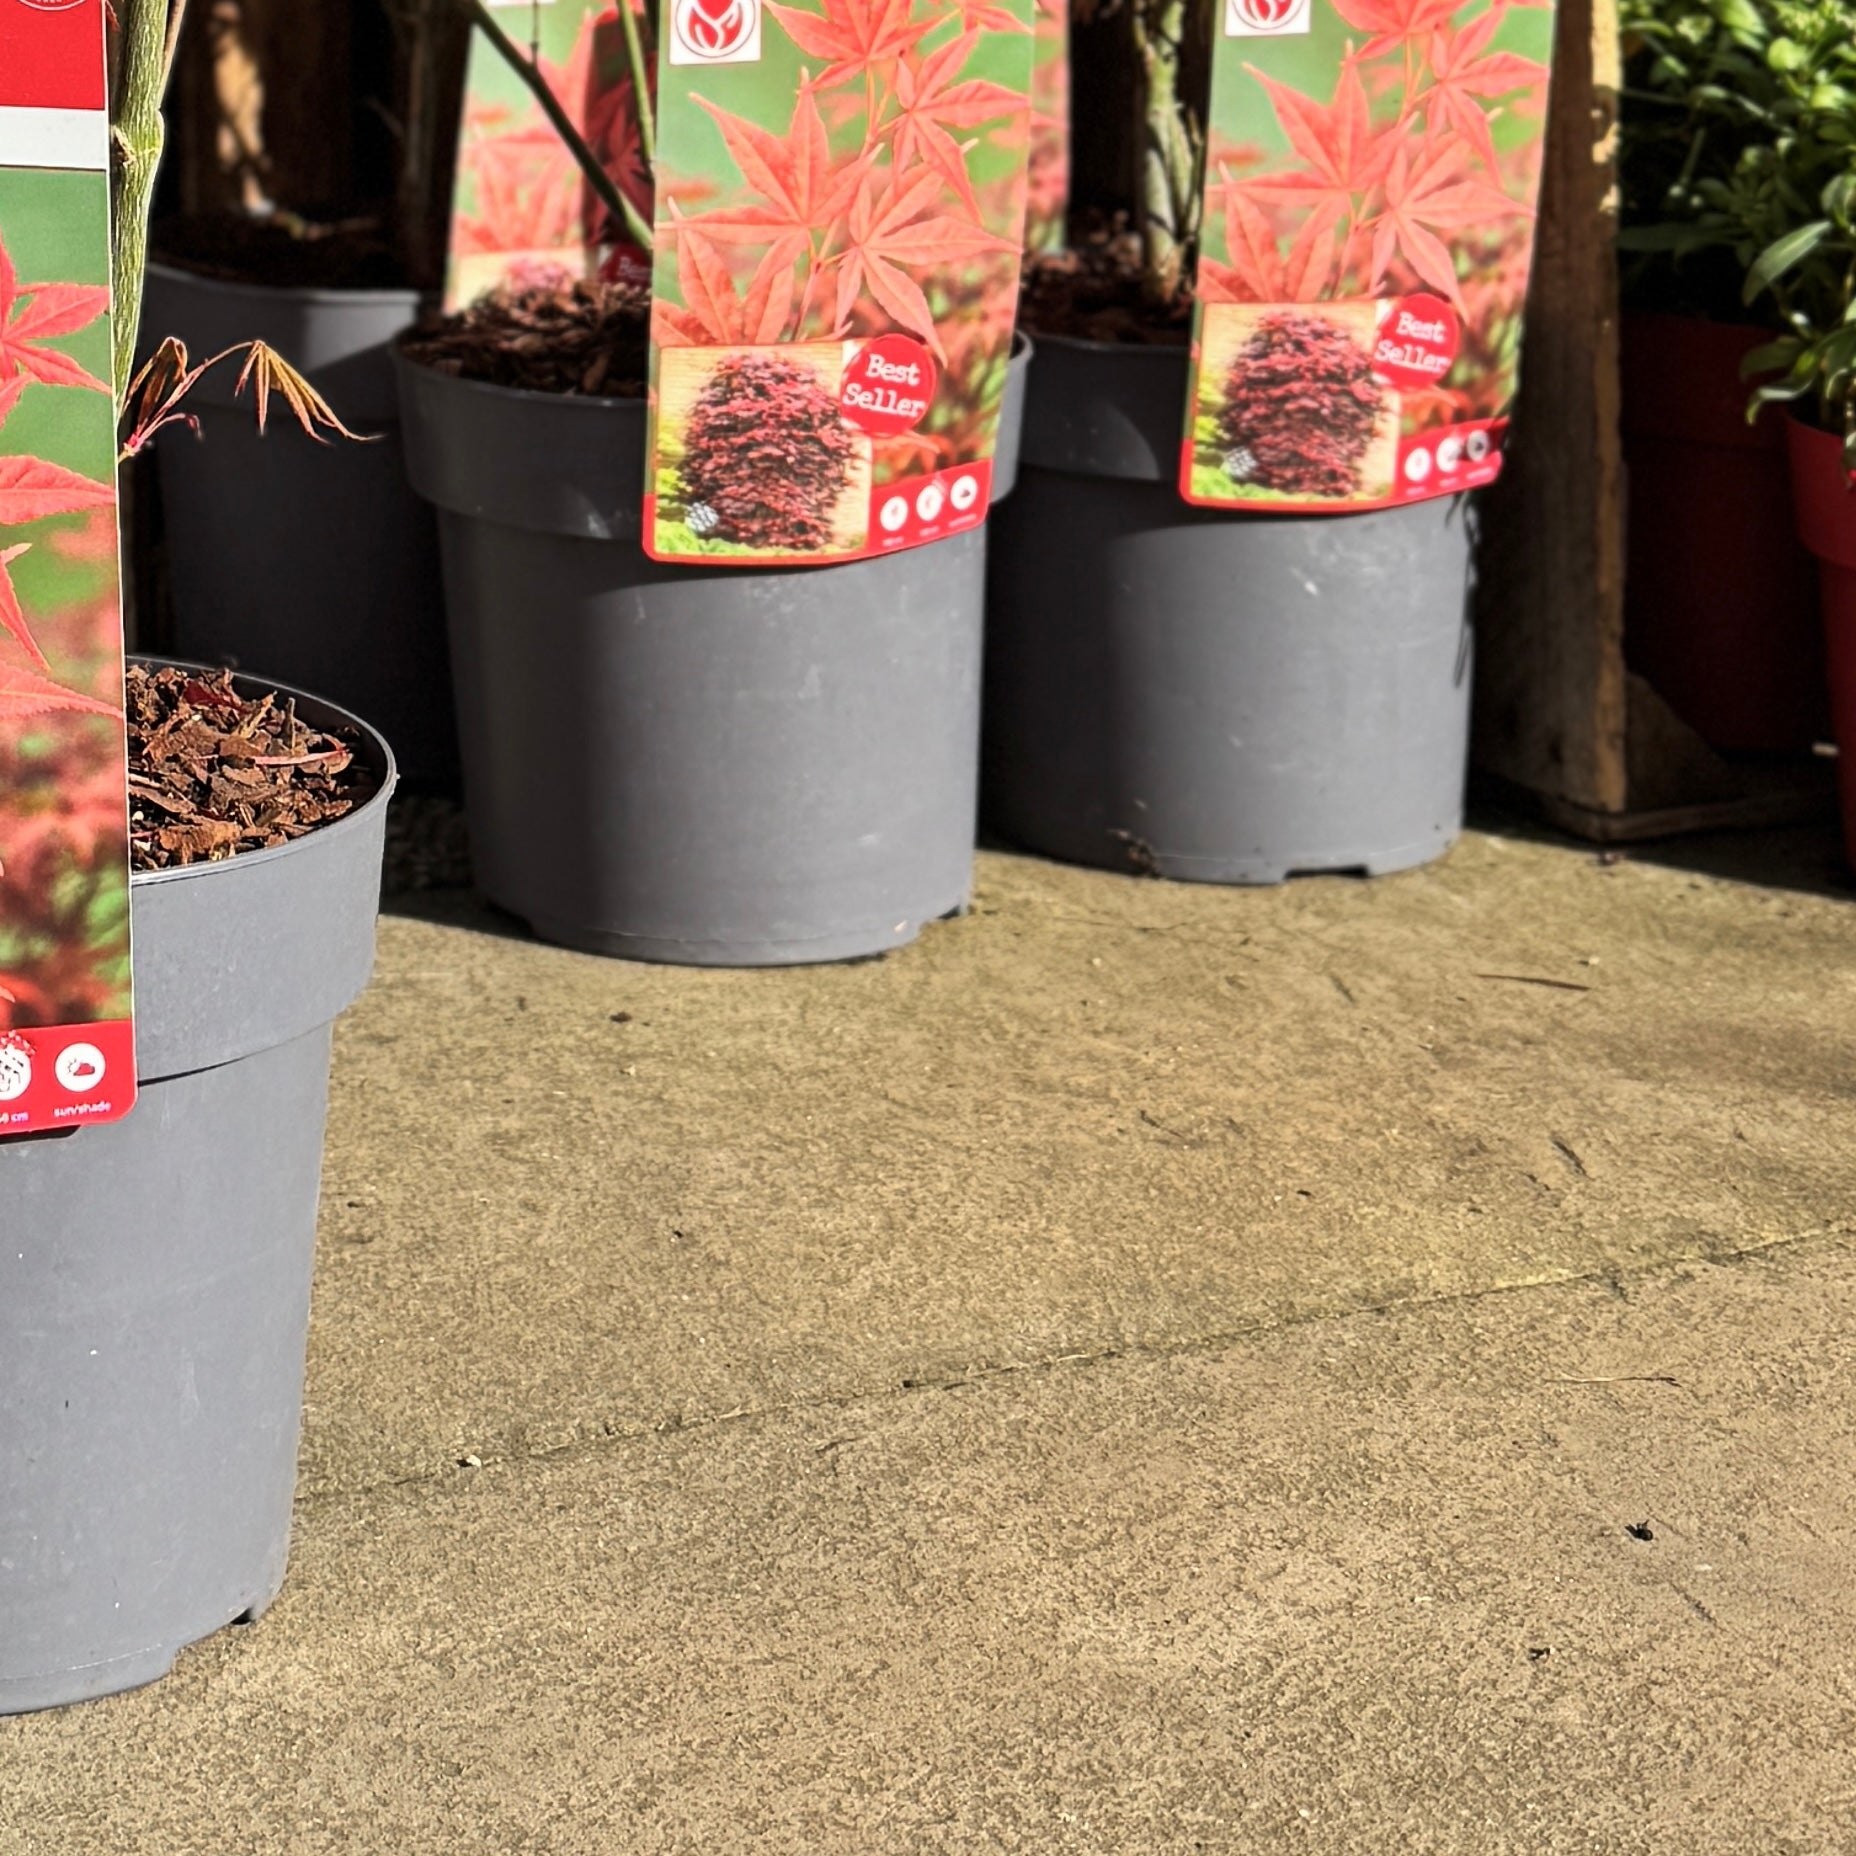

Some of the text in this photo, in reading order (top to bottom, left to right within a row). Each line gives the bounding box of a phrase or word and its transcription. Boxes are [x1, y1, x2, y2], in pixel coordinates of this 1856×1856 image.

[1396, 311, 1445, 343] Best
[866, 353, 921, 386] Best
[1374, 340, 1451, 373] Seller
[842, 383, 926, 418] Seller
[11, 1111, 29, 1122] cm
[54, 1100, 112, 1117] sun/shade
